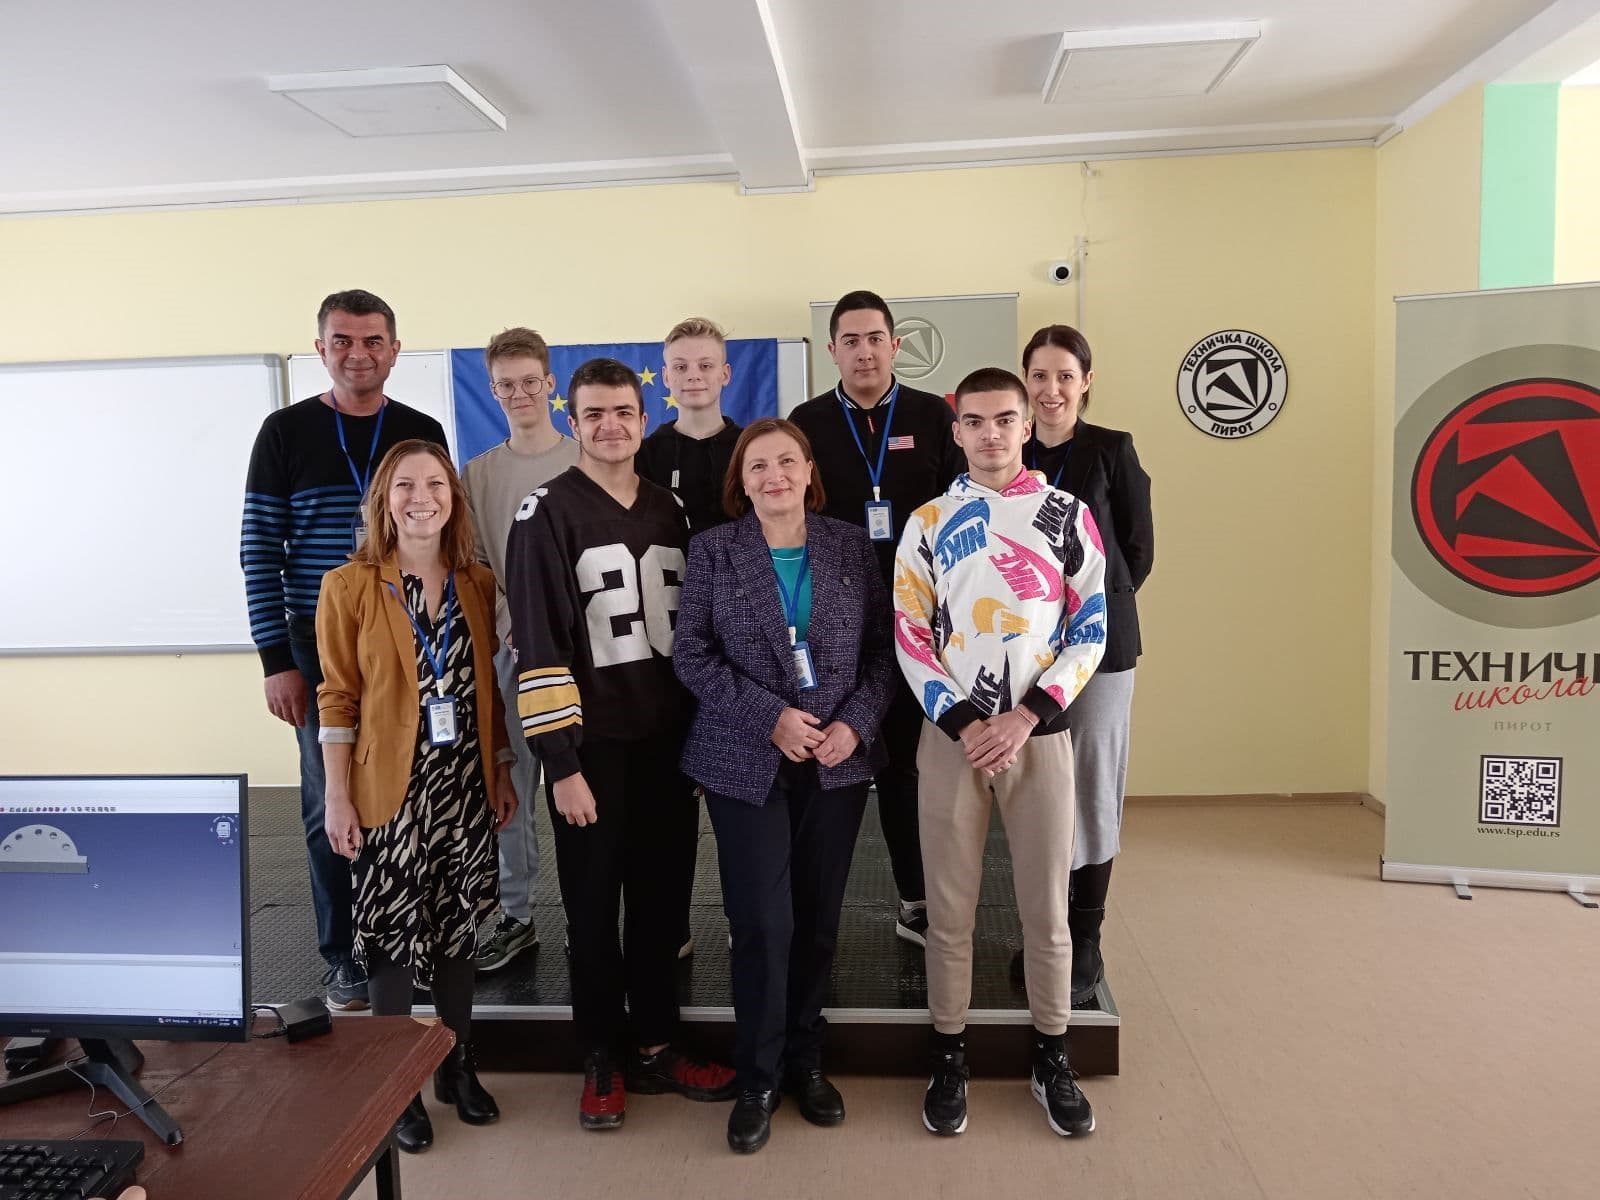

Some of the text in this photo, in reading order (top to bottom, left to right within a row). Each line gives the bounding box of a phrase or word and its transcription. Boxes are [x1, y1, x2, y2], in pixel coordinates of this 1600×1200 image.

[1182, 333, 1282, 374] ТЕХНИЧКА ШКОЛА
[1210, 421, 1254, 436] ПИРОТ
[1031, 491, 1072, 544] NIKE
[940, 520, 987, 575] NIKE
[988, 549, 1046, 601] NIKE
[575, 543, 686, 668] 26
[1454, 676, 1596, 711] школа
[1494, 720, 1553, 732] ПИРОТ
[1477, 822, 1561, 838] www.tsp.edu.rs
